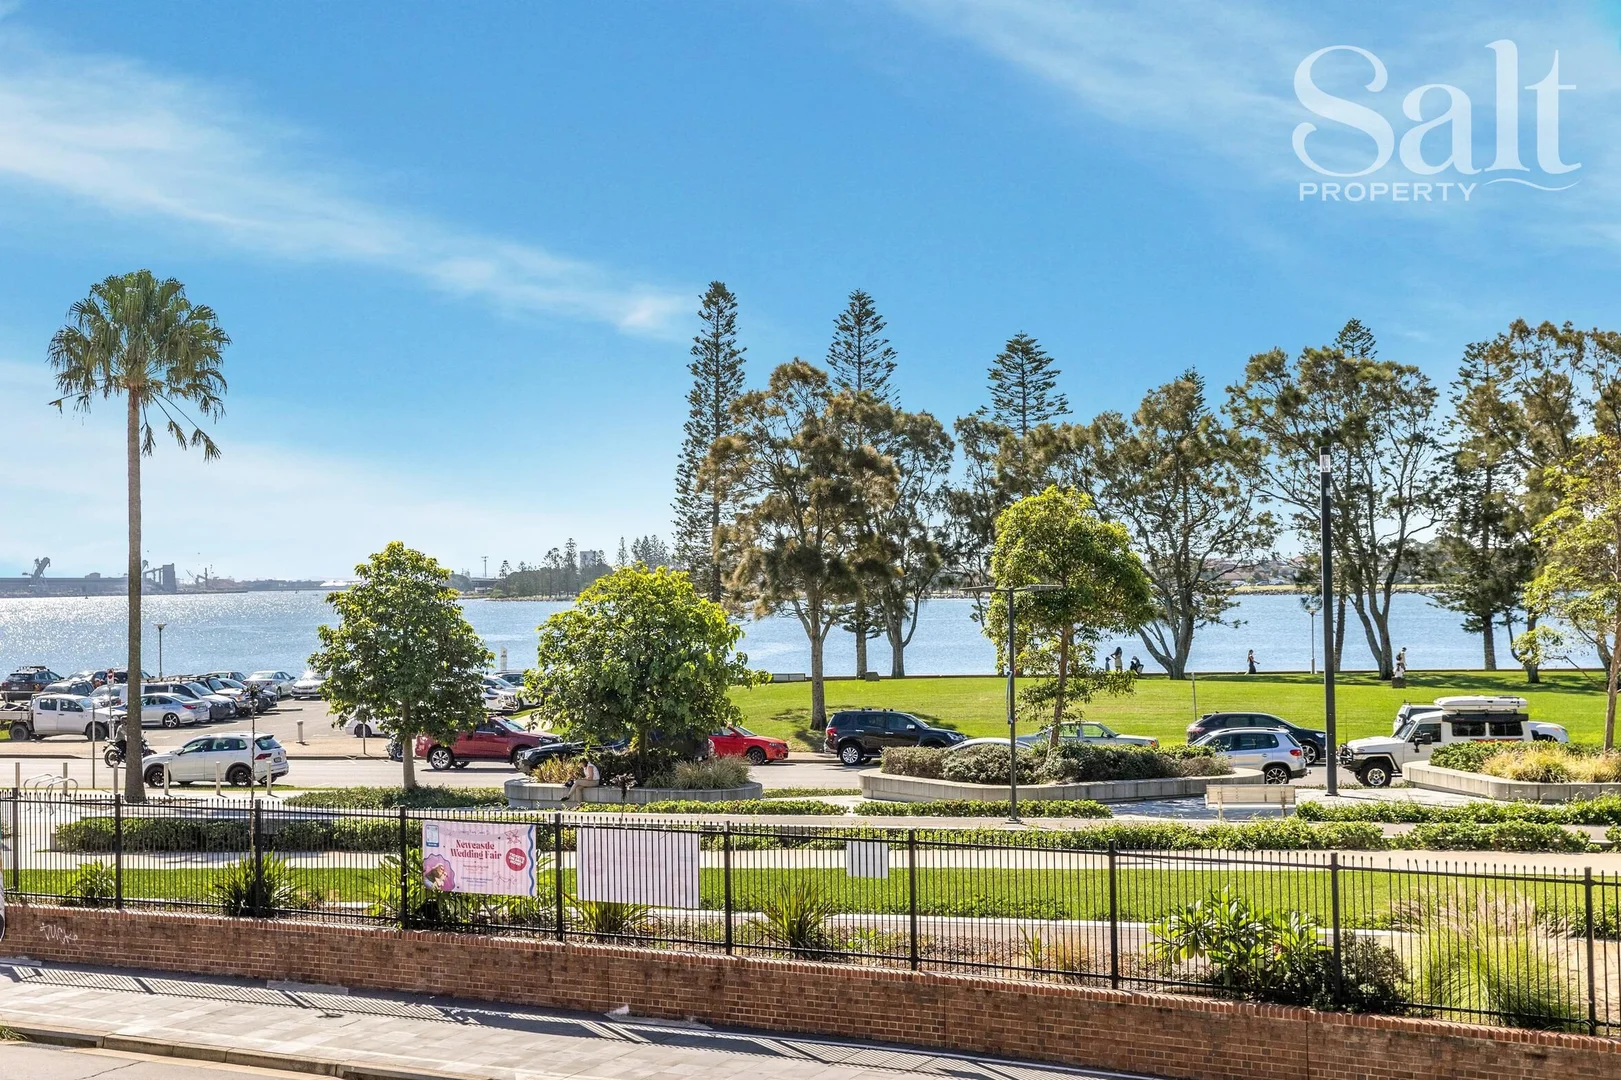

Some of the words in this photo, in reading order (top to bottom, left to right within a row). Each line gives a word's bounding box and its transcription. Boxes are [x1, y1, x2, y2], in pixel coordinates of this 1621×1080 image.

[455, 839, 495, 850] Newcastle
[450, 848, 483, 860] Wedding
[485, 851, 502, 860] Fair
